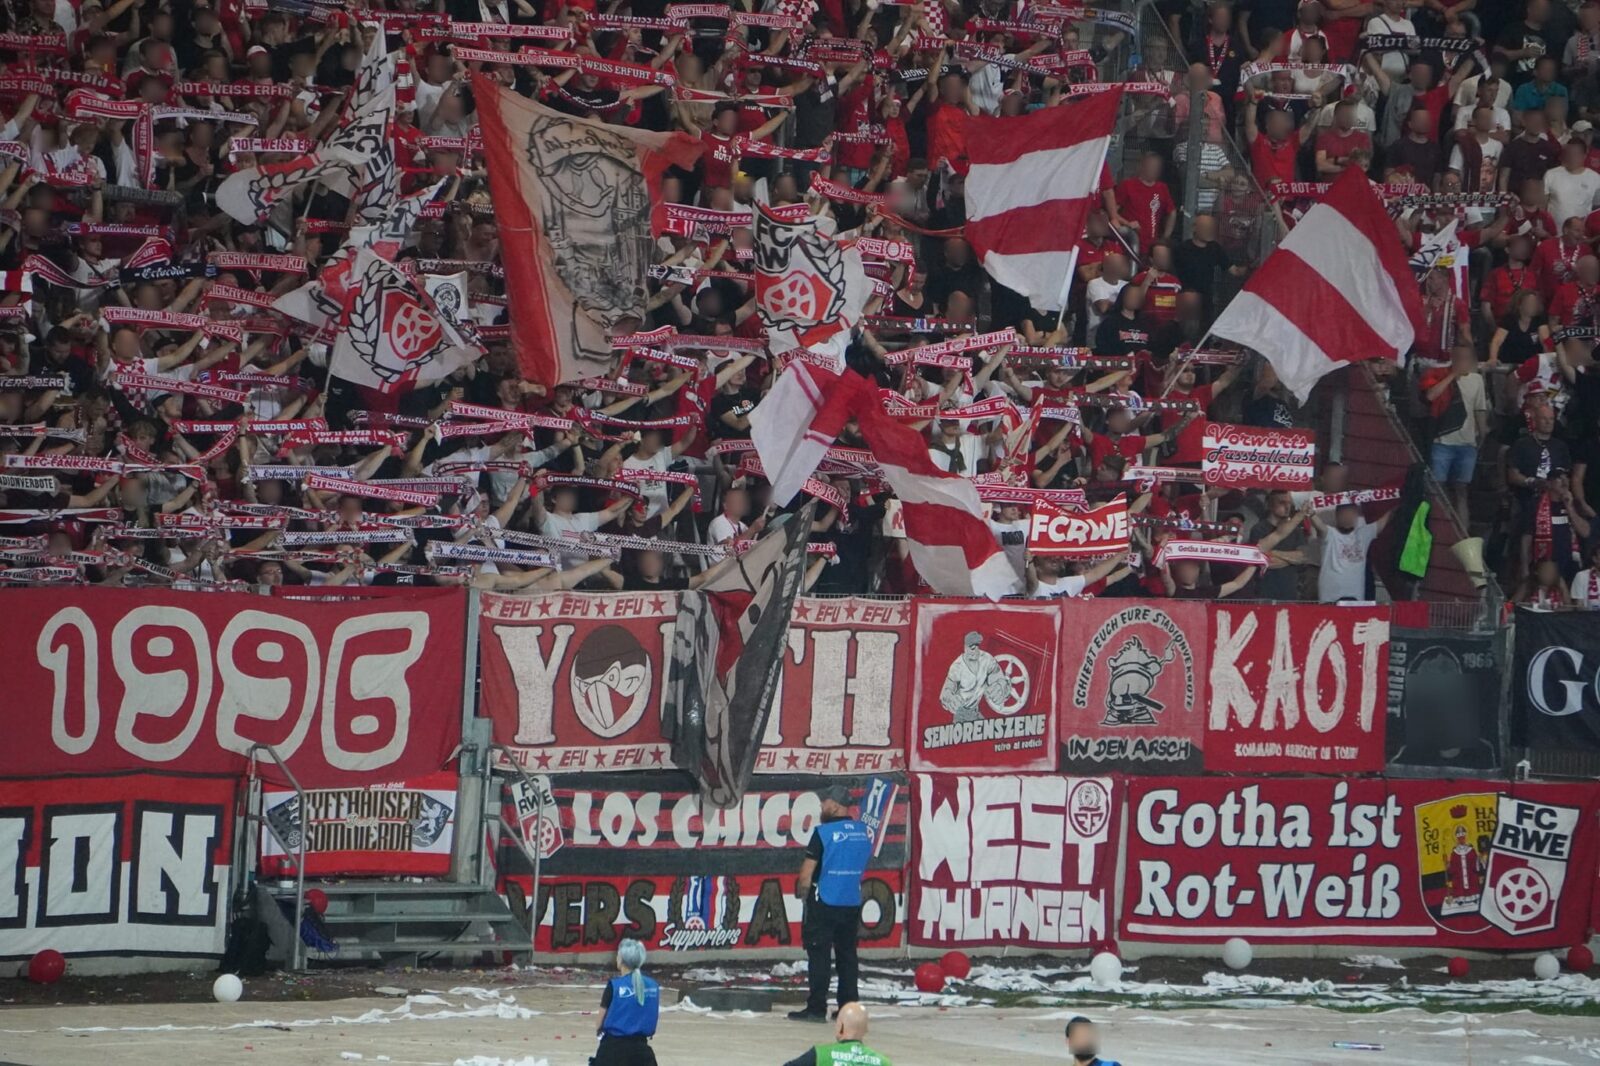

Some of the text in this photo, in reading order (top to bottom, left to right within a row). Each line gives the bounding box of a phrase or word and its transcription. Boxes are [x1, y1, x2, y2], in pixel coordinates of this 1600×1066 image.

[21, 80, 56, 98] ERFUR
[614, 67, 652, 80] ERFURT
[1206, 423, 1309, 449] Vorwärts
[1207, 445, 1311, 466] Fussballclub
[1206, 462, 1310, 484] Rot-Weiss
[1030, 511, 1129, 545] FCRWE
[1177, 545, 1199, 555] Gotha
[500, 597, 894, 623] EFU EFU EFU EFU EFU
[1075, 645, 1097, 707] SCHIEBT
[1093, 619, 1119, 649] EUCH
[1120, 608, 1151, 625] EURE
[1209, 608, 1391, 733] KAOT
[37, 605, 430, 773] 1996
[493, 623, 900, 748] YOH
[1387, 641, 1408, 718] ERFURT
[924, 714, 1046, 749] SENIORENSZENE
[1068, 737, 1191, 760] IN DEN ARSCH
[558, 749, 589, 768] EFU
[611, 748, 645, 768] EFU
[805, 751, 832, 771] EFU
[853, 751, 884, 771] EFU
[572, 790, 823, 848] LOS CHICO
[918, 774, 1113, 886] WEST
[1136, 781, 1403, 849] Gotha ist
[1516, 801, 1558, 831] FC
[1497, 822, 1569, 857] RWE
[1133, 853, 1402, 920] Rot-Weiß
[917, 879, 1105, 943] THÜRINGEN
[659, 922, 742, 951] Supporters
